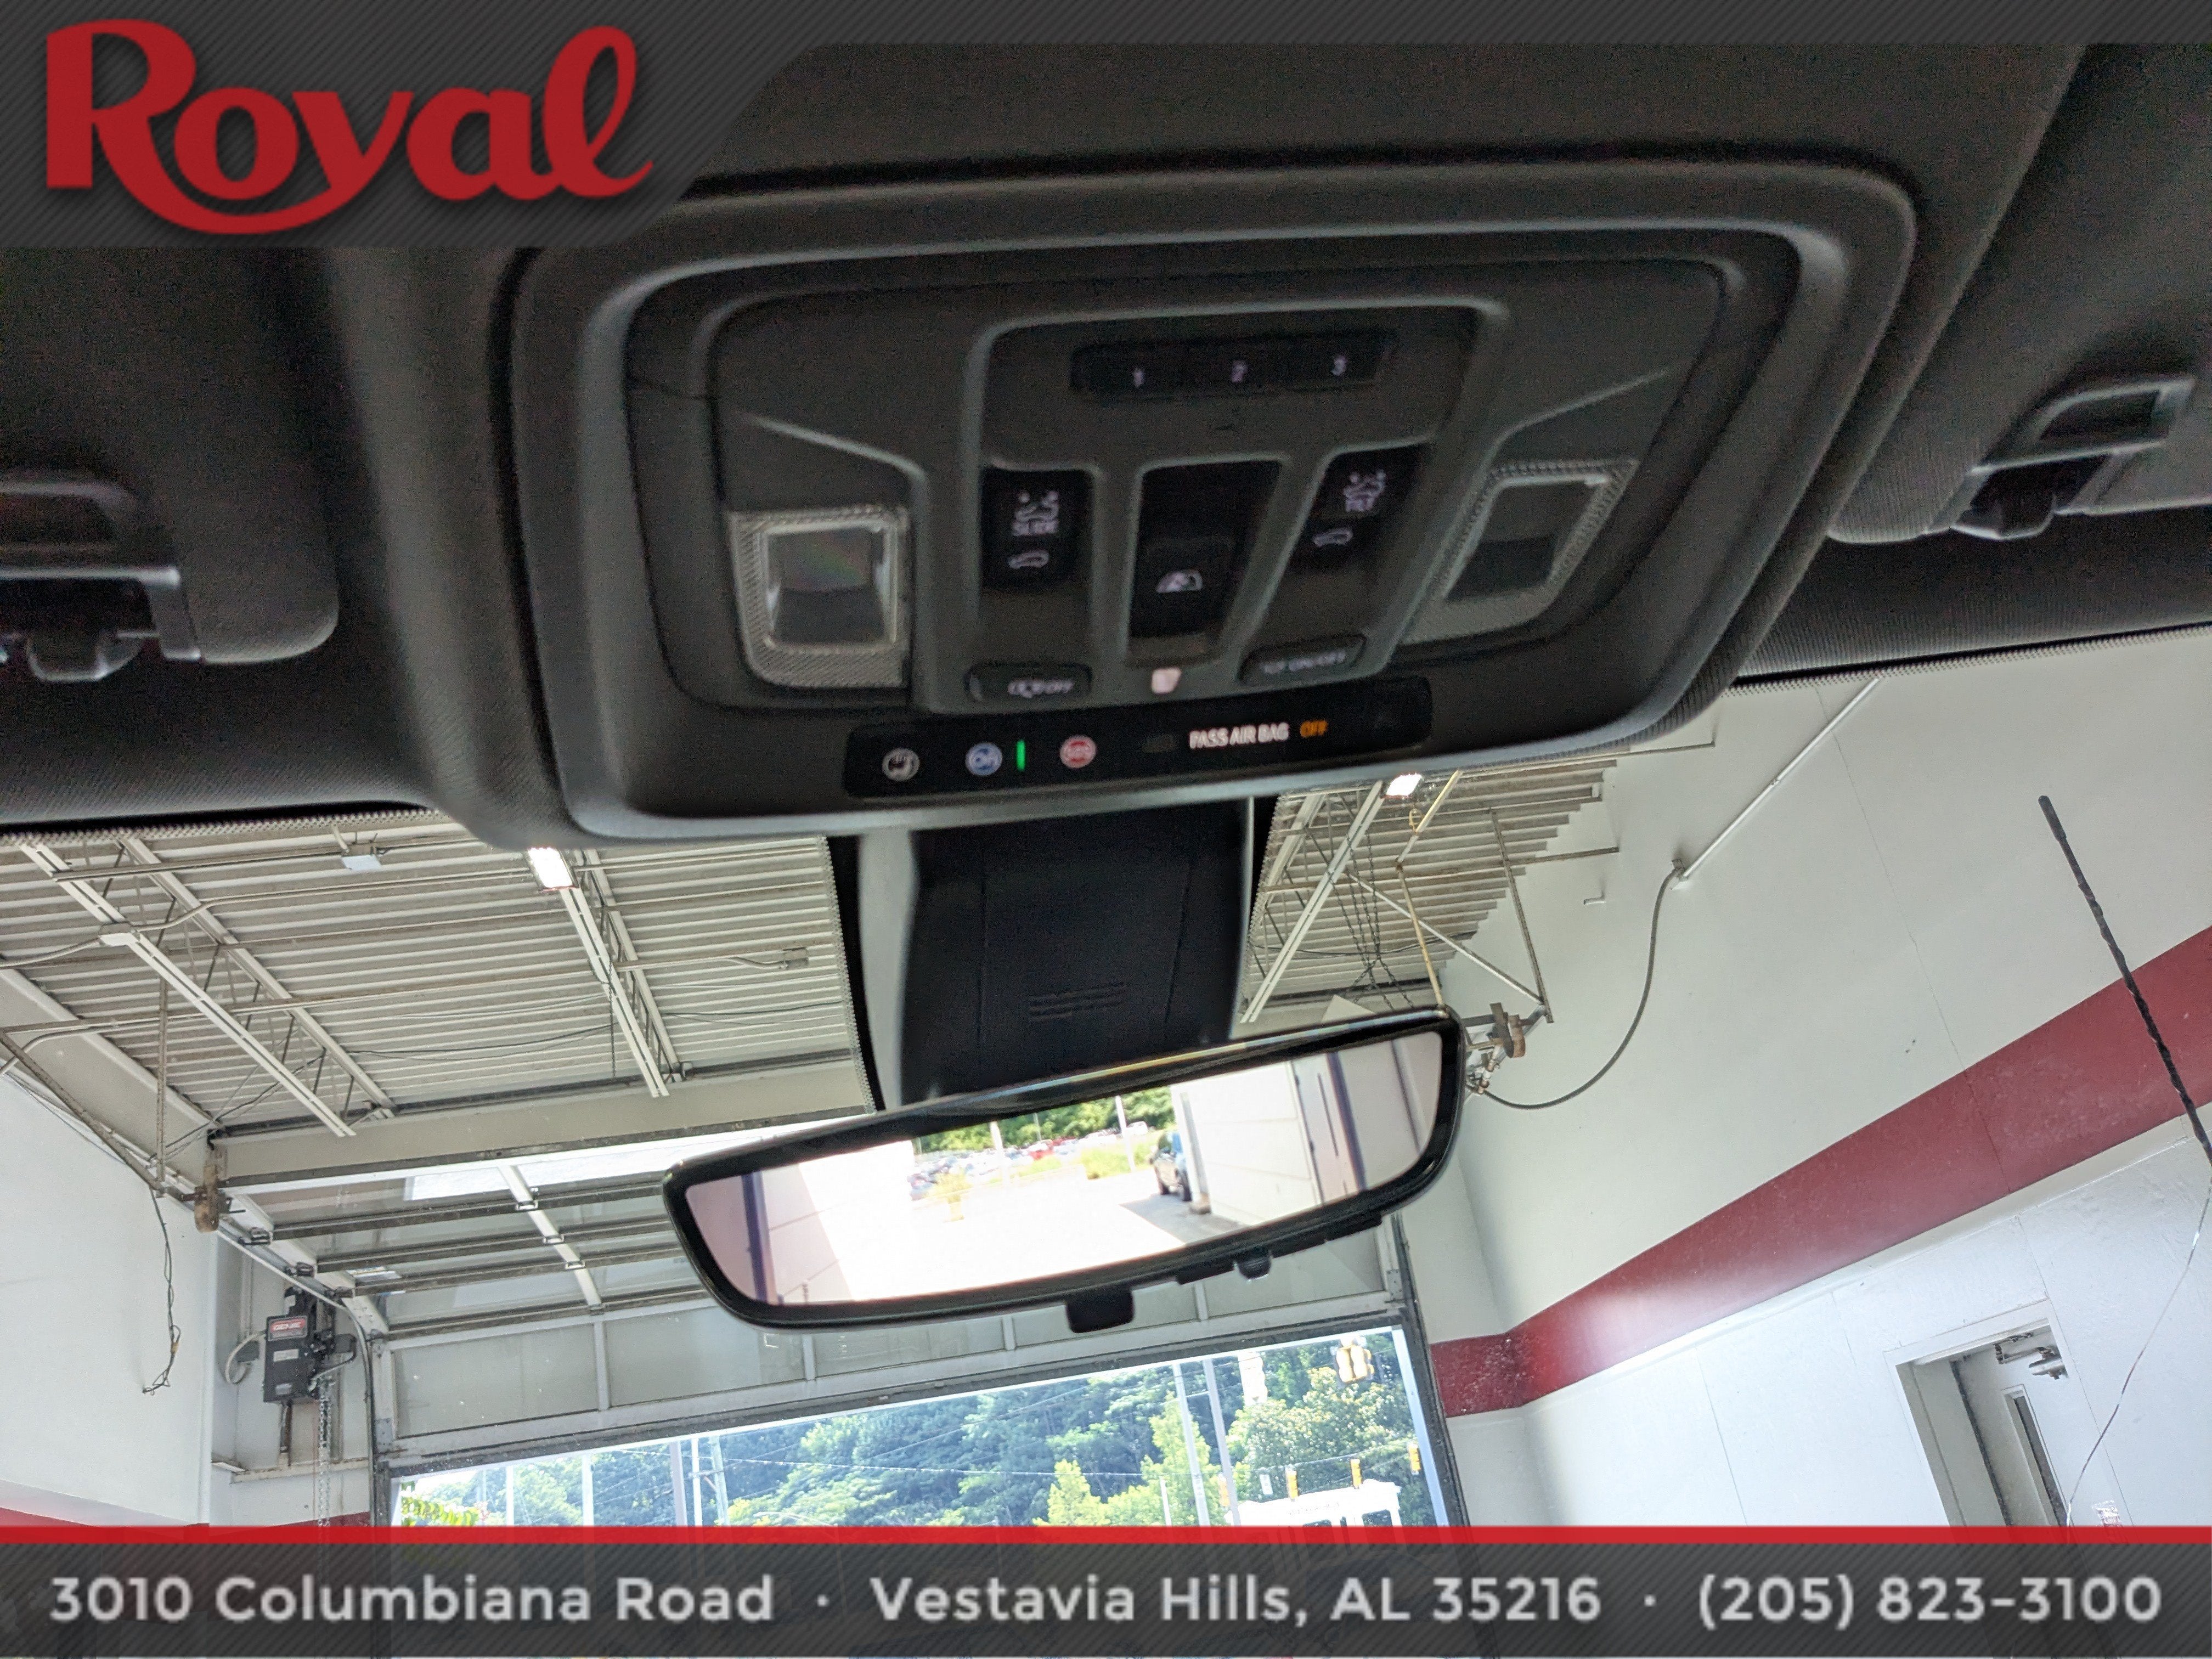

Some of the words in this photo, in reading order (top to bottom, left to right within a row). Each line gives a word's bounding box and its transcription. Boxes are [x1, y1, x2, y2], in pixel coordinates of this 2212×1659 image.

[1188, 727, 1229, 749] PASS
[1229, 724, 1257, 746] AIR
[1257, 721, 1289, 743] BAG
[1299, 720, 1328, 738] OFF
